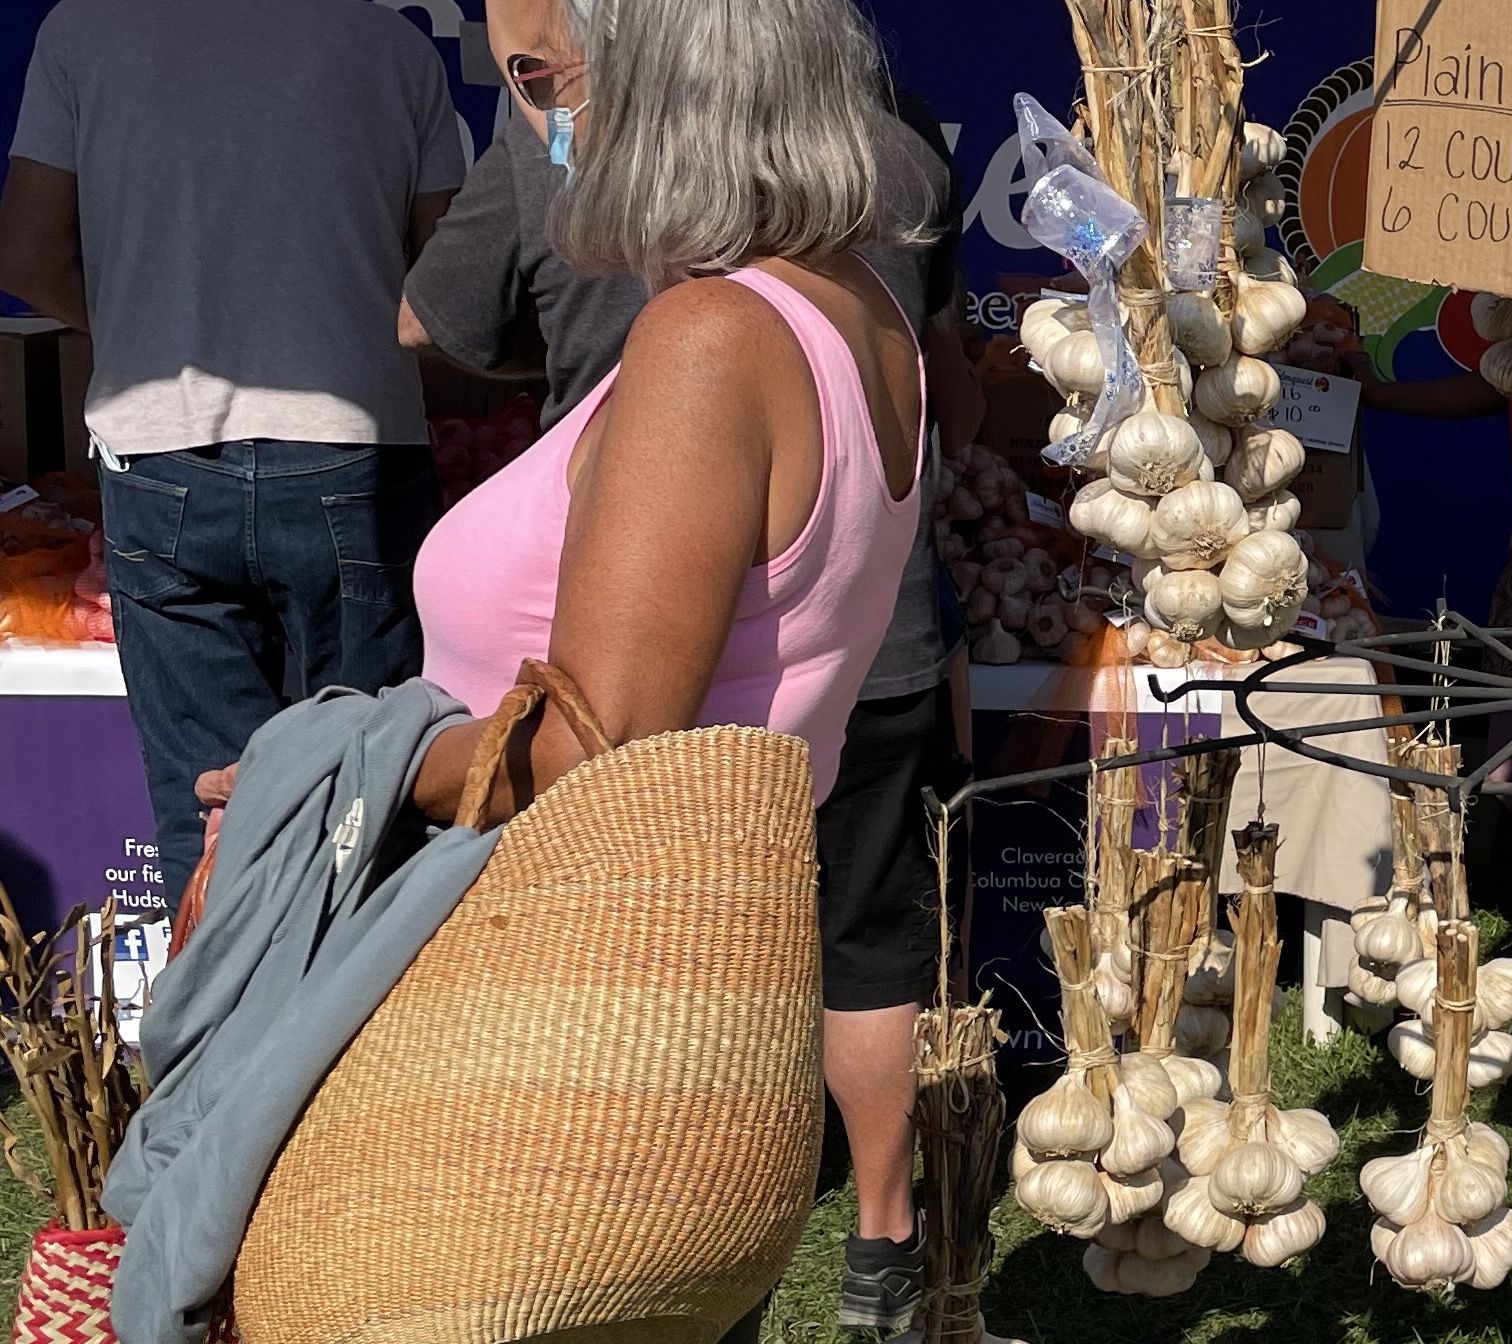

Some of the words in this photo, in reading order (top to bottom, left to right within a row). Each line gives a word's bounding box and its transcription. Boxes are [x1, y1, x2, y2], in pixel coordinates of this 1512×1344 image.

[1391, 27, 1504, 105] Plain
[1385, 119, 1425, 171] 12
[1381, 186, 1412, 233] 6
[105, 868, 137, 883] our
[1002, 896, 1042, 913] New
